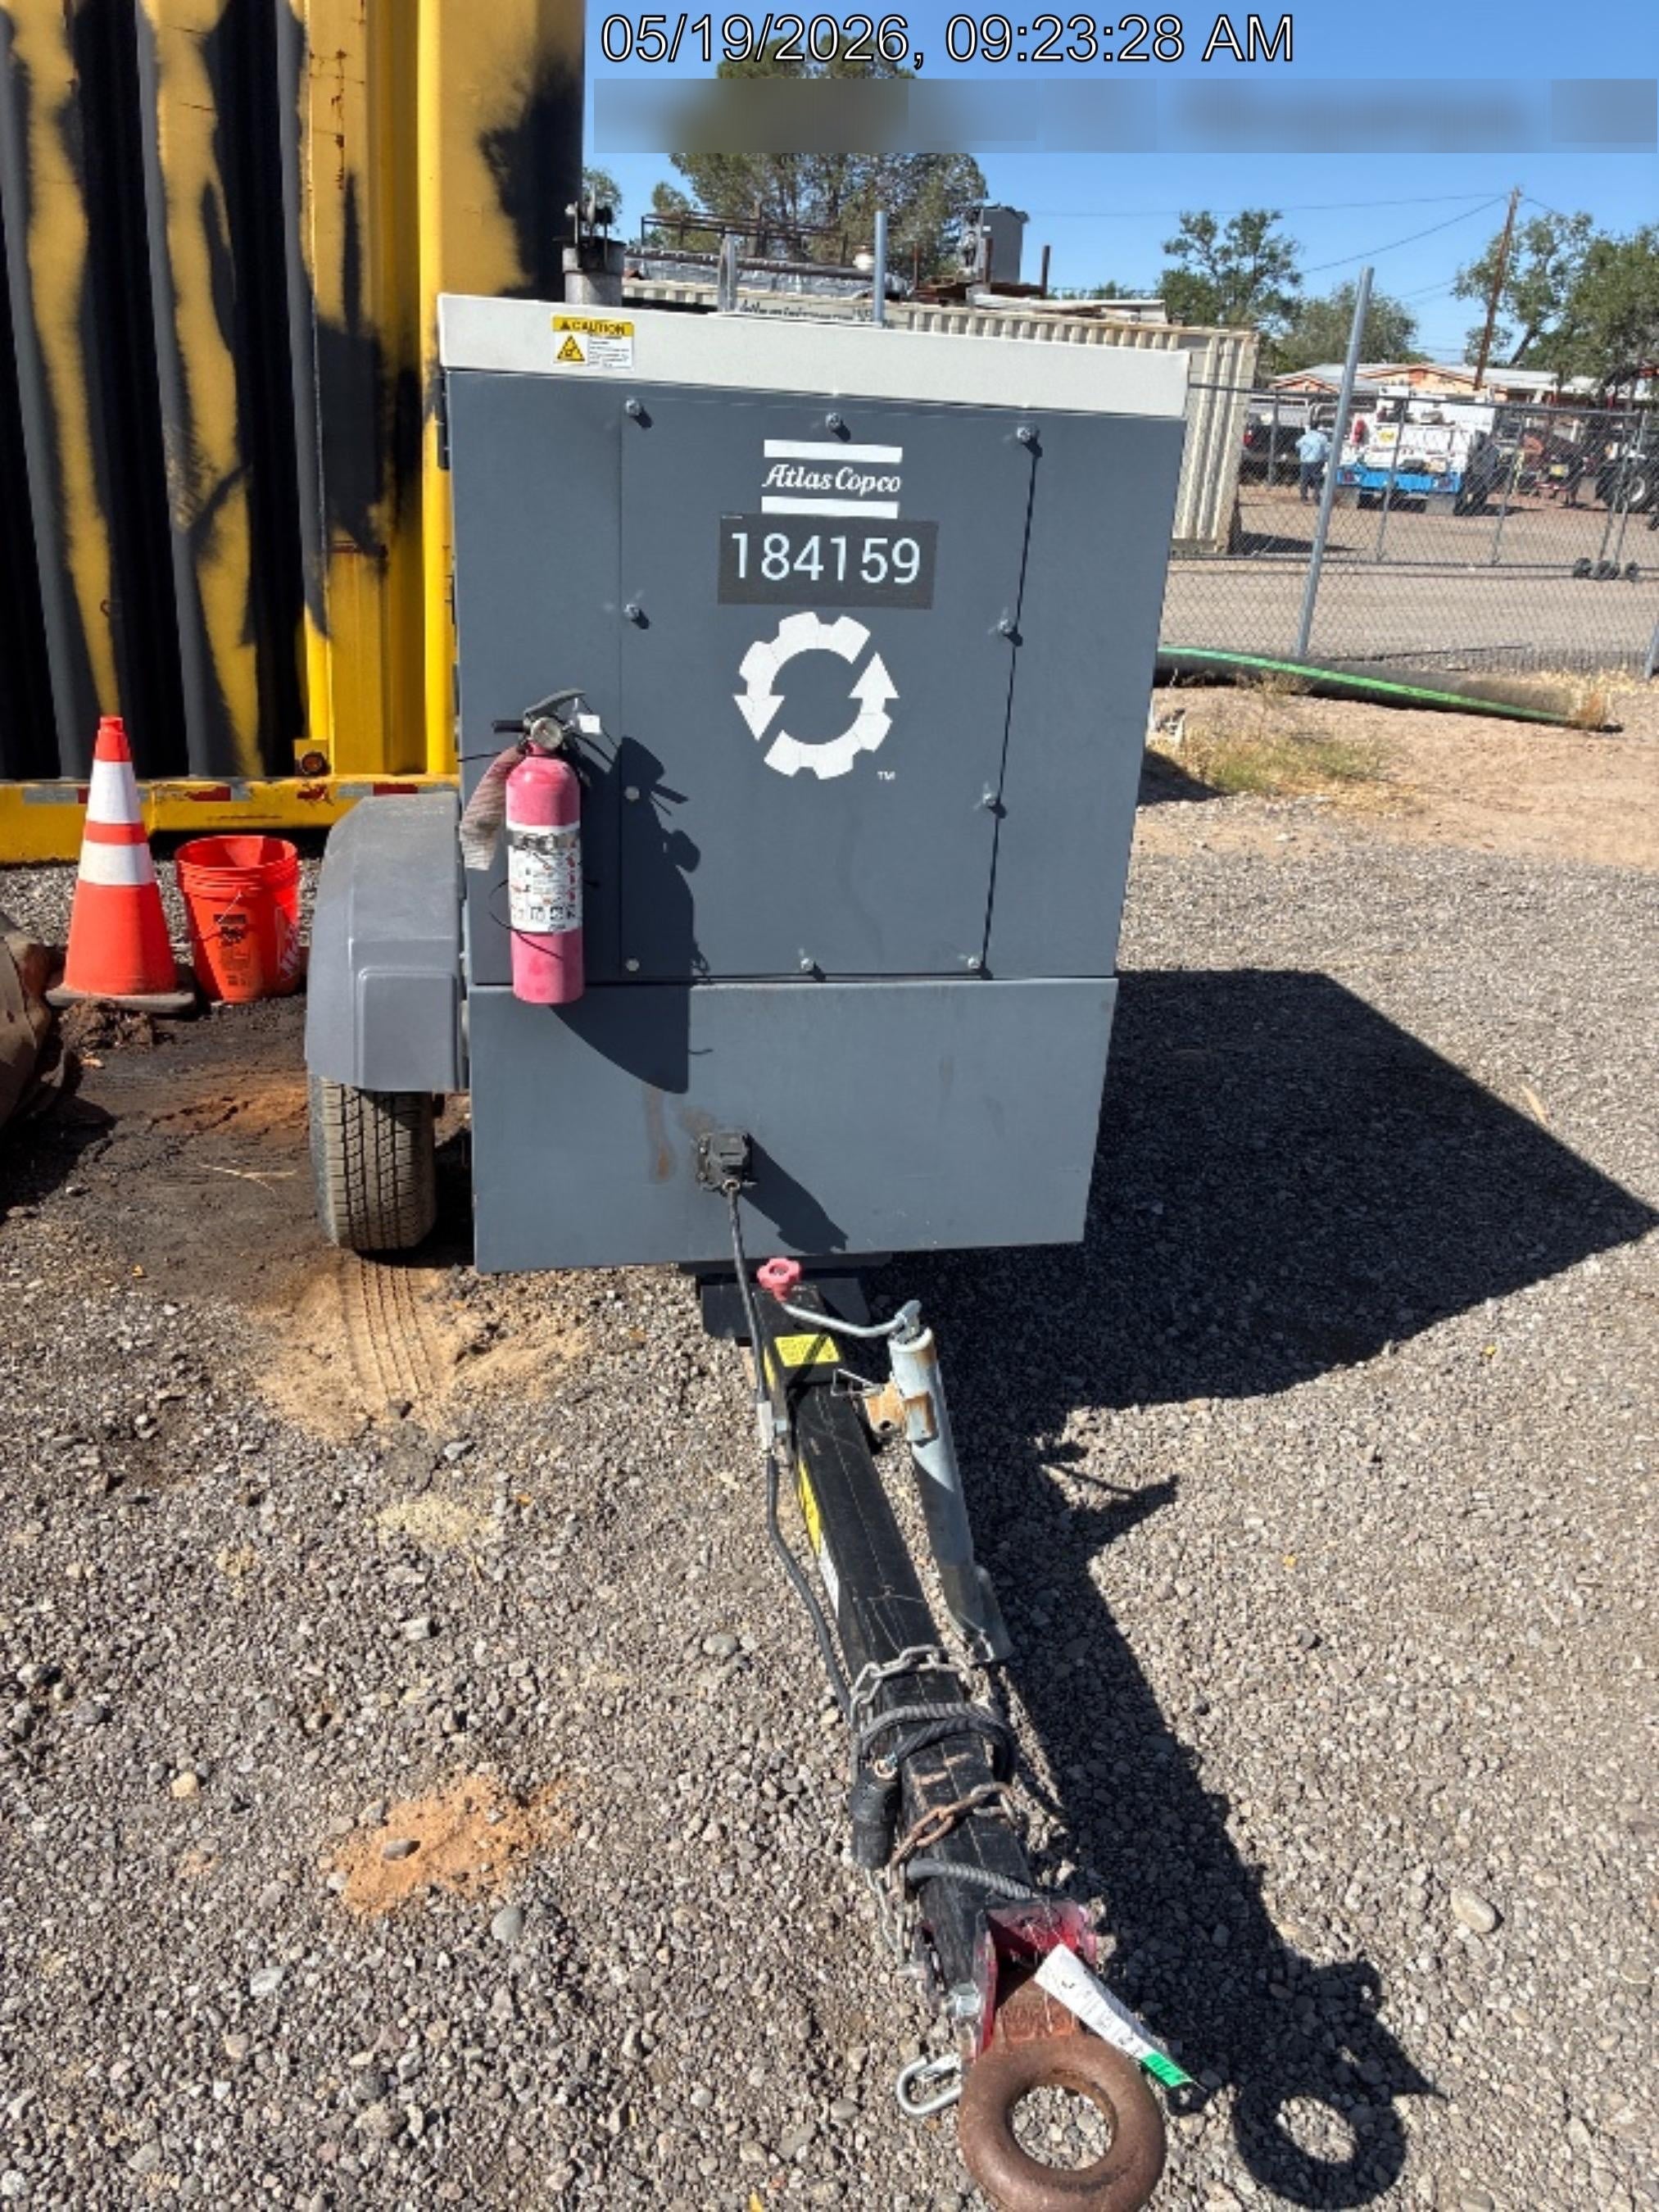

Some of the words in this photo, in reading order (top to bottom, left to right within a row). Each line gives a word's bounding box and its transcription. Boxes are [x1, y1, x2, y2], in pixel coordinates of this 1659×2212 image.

[571, 320, 626, 336] CAUTION
[761, 464, 833, 490] Atlas
[835, 466, 901, 497] Copco
[731, 532, 921, 584] 184159
[877, 771, 895, 781] TM
